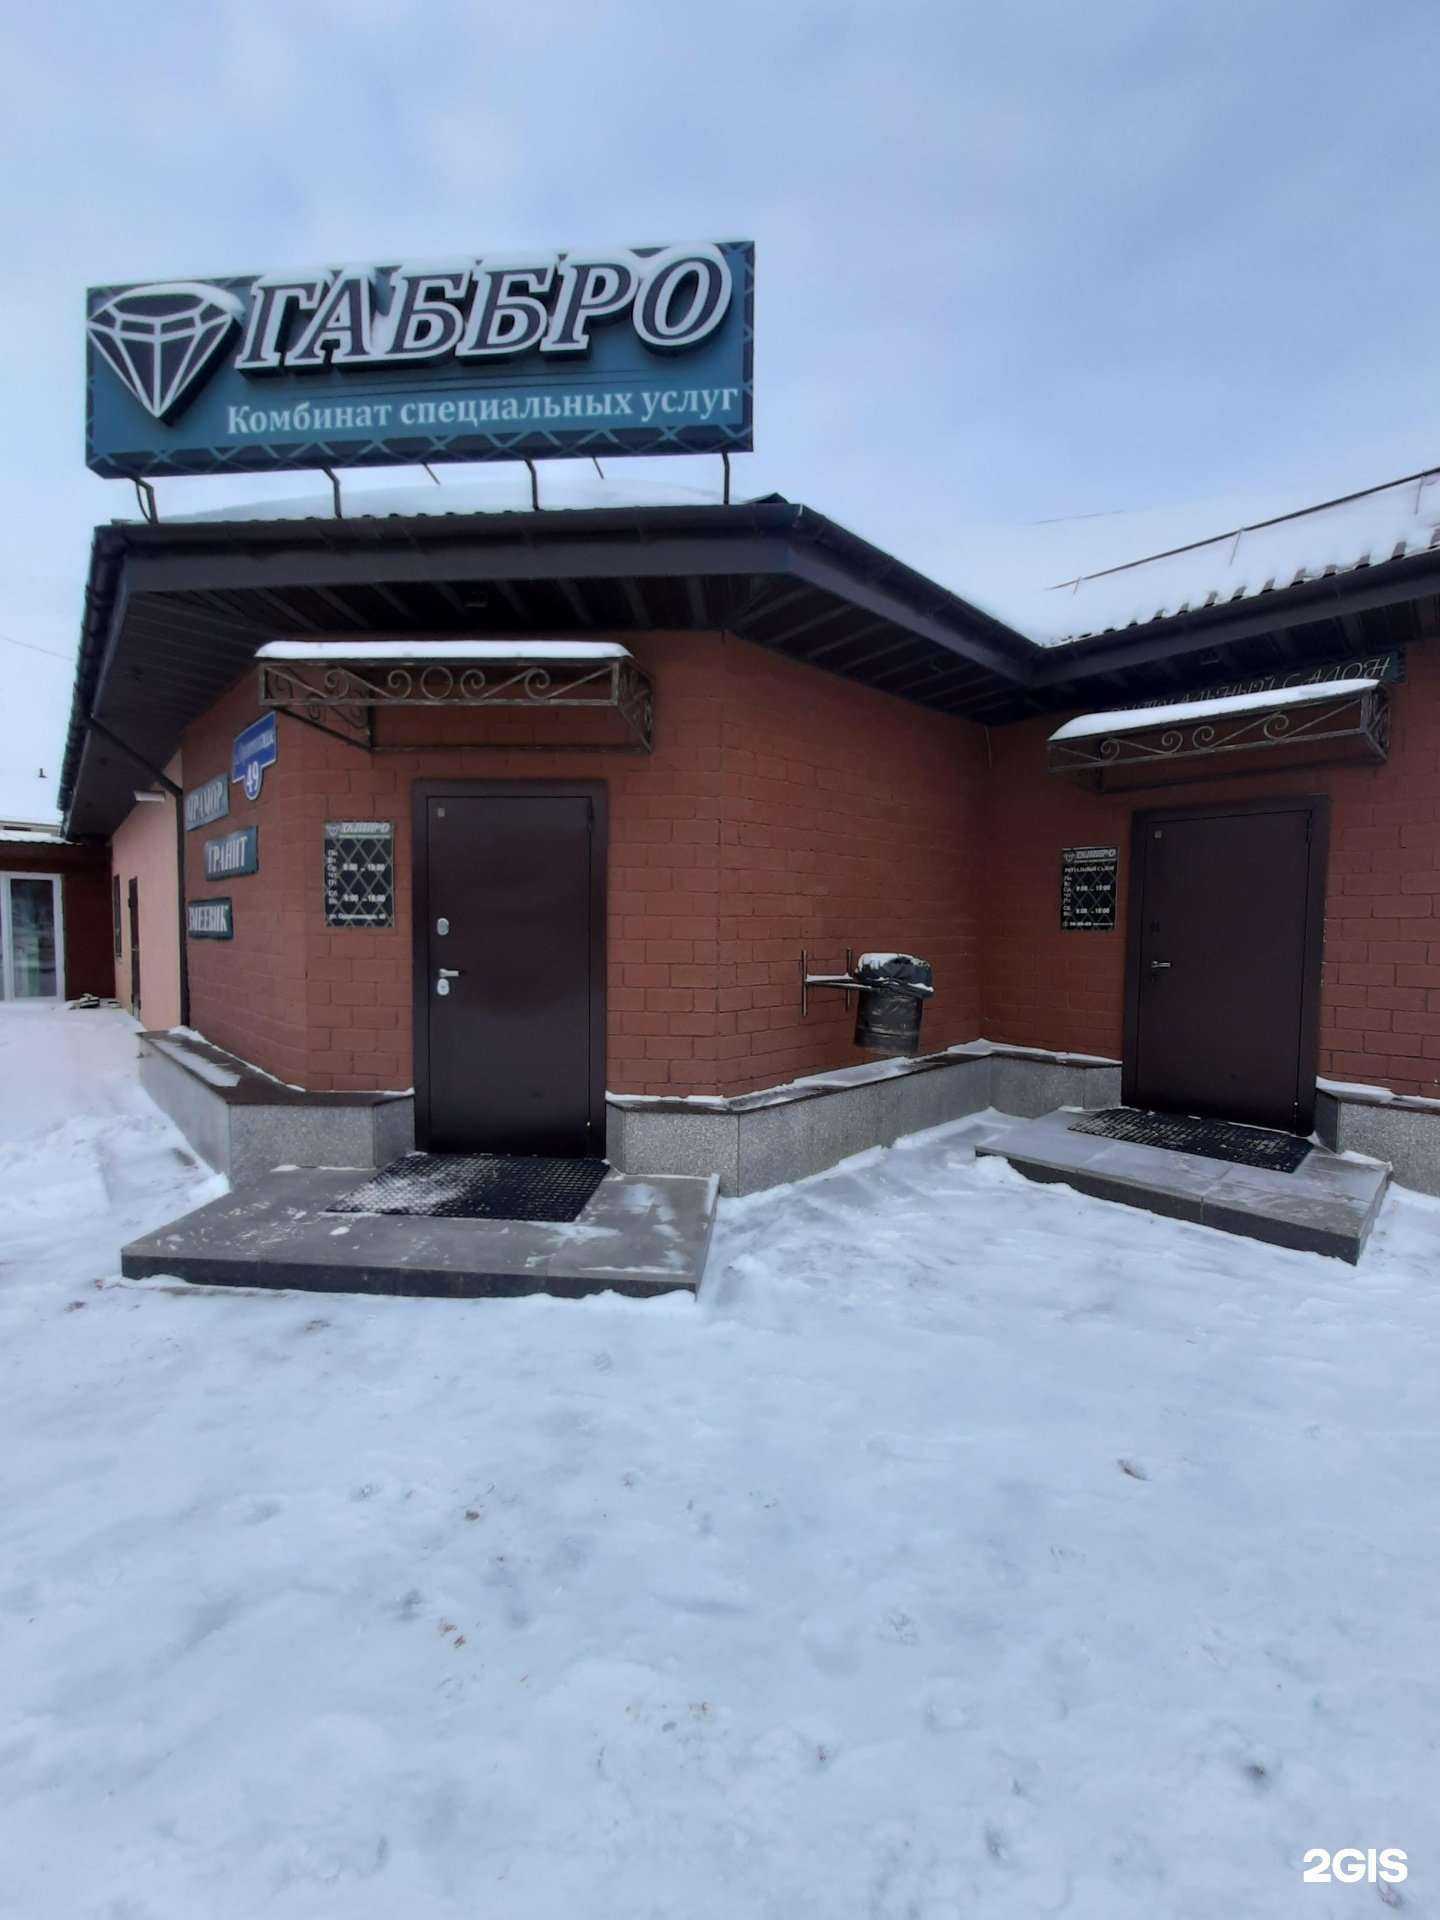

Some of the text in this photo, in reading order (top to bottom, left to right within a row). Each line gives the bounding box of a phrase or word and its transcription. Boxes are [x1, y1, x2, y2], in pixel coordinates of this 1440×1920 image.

[234, 246, 733, 371] ГАББРО
[227, 388, 739, 434] Комбинат специальных услуг
[246, 761, 260, 793] 49
